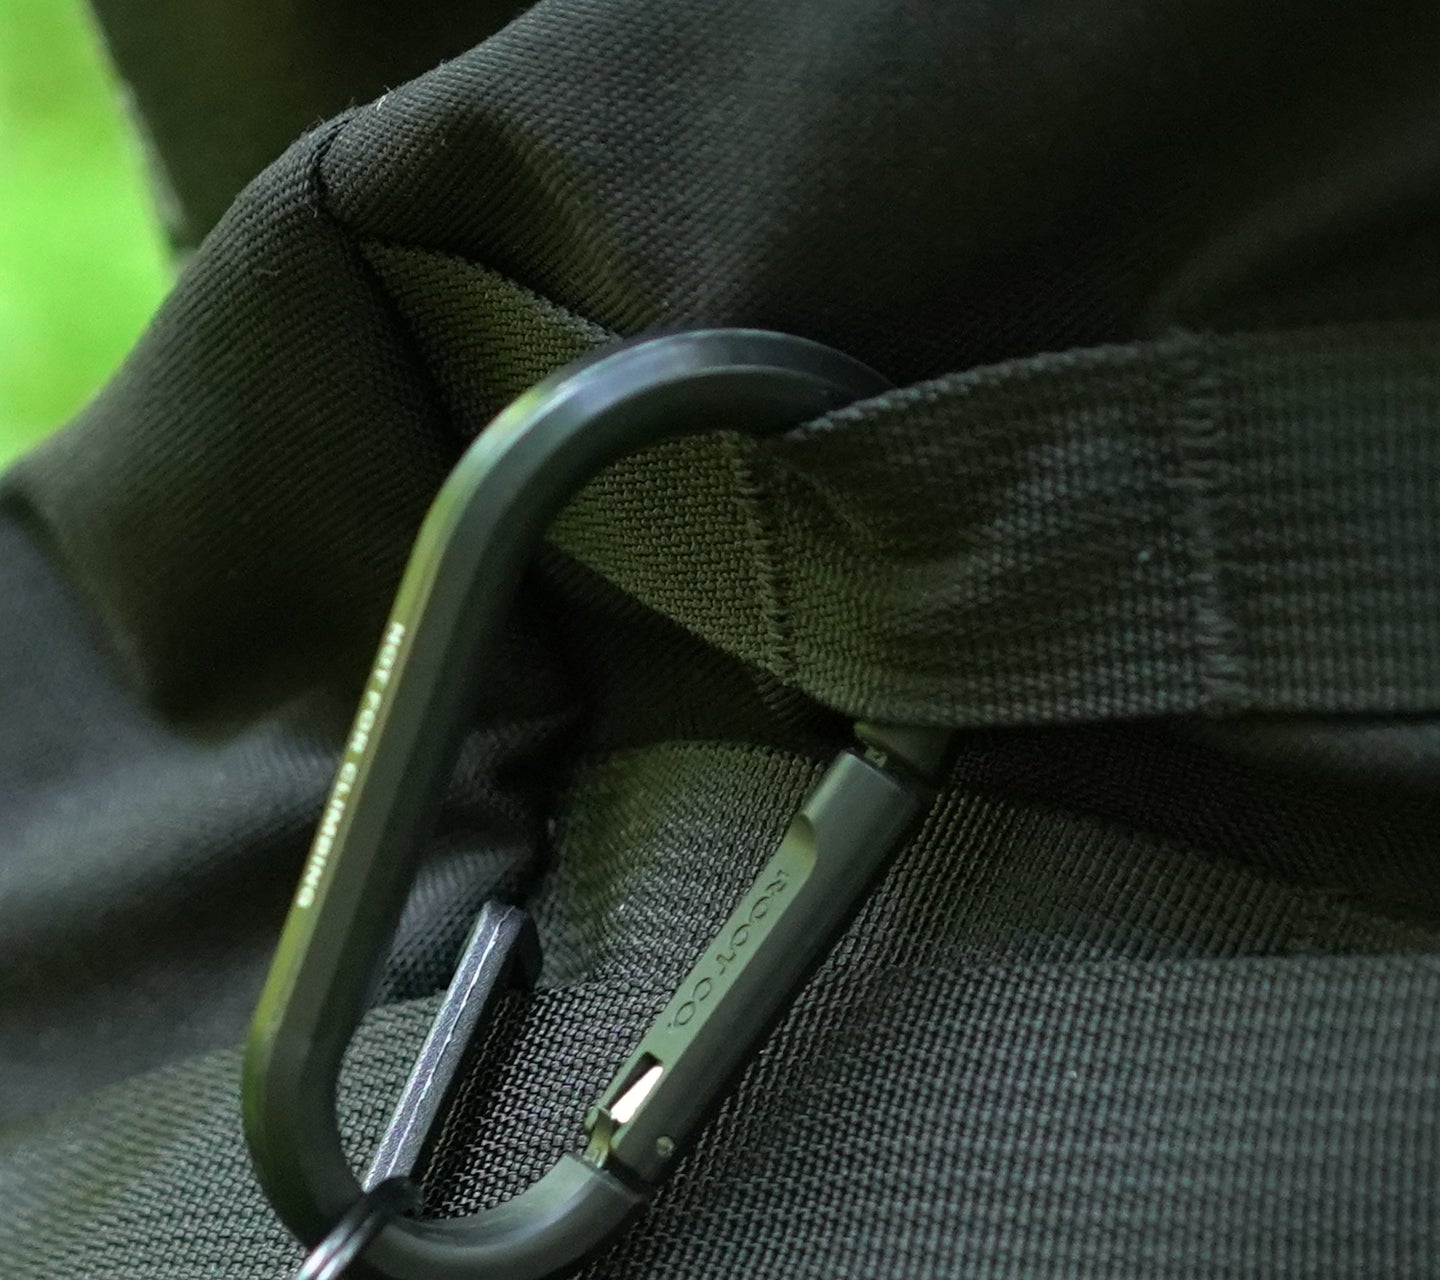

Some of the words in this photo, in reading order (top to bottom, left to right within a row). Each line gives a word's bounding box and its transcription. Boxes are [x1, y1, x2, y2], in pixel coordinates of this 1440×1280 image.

[376, 622, 405, 686] NOT
[350, 690, 381, 753] FOR
[296, 762, 357, 909] CLIMBING
[715, 869, 790, 975] ROOT
